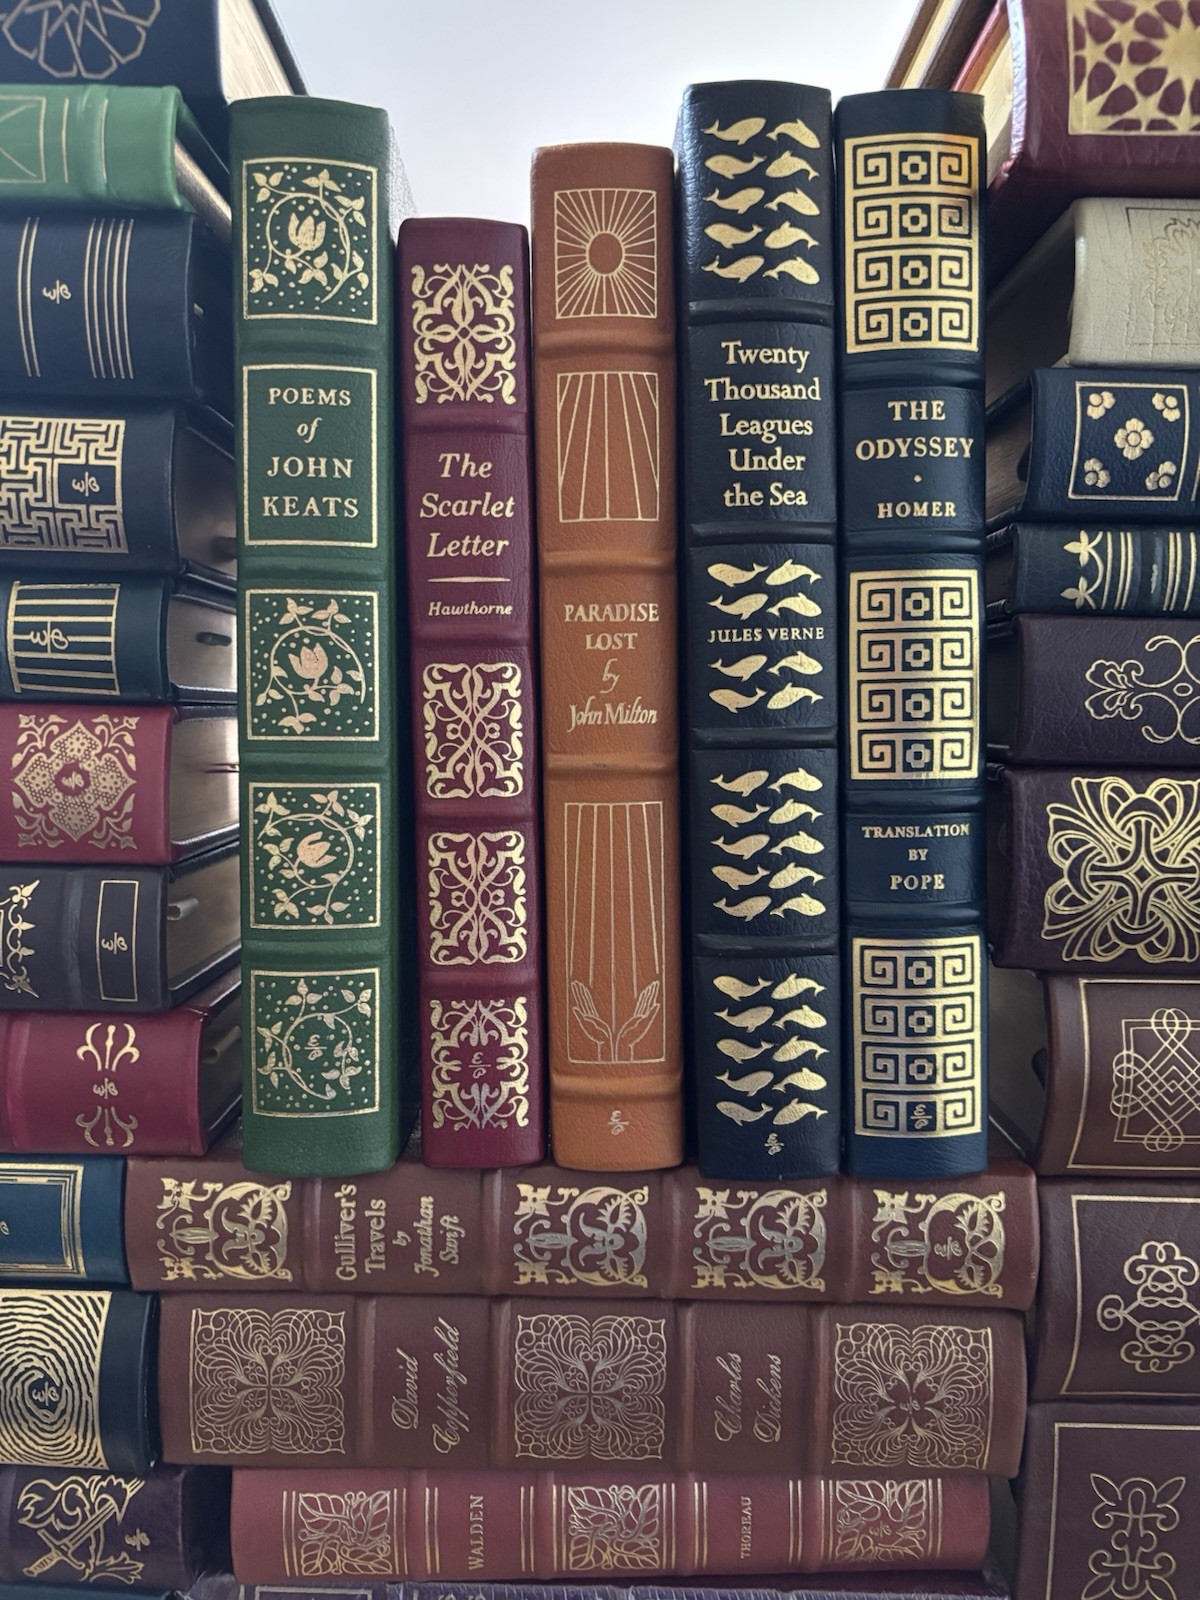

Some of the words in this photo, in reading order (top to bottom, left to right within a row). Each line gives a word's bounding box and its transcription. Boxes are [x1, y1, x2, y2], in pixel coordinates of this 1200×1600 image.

[721, 340, 810, 373] Twenty
[268, 387, 352, 407] POEMS
[704, 377, 822, 402] Thousand
[888, 400, 946, 421] THE
[296, 417, 323, 444] of
[719, 413, 814, 444] Leagues
[728, 446, 806, 472] Under
[855, 437, 974, 461] ODYSSEY
[266, 456, 354, 479] JOHN
[438, 453, 493, 479] The
[262, 496, 359, 518] KEATS
[419, 492, 515, 519] Scarlet
[723, 484, 764, 507] the
[769, 482, 809, 507] Sea
[877, 501, 957, 519] HOMER
[426, 533, 510, 558] Letter
[428, 601, 514, 617] Hawthorne
[564, 603, 660, 623] PARADISE
[585, 633, 638, 651] LOST
[708, 628, 763, 644] JULES
[766, 627, 825, 641] VERNE
[600, 658, 621, 694] by
[566, 695, 603, 733] John
[604, 696, 659, 725] Milton
[861, 823, 970, 839] TRANSLATION
[908, 848, 929, 861] BY
[889, 873, 945, 891] POPE
[333, 1183, 358, 1282] Gulliver's
[364, 1198, 387, 1274] Travels
[392, 1230, 412, 1247] by
[412, 1195, 440, 1278] Jonathan
[438, 1214, 466, 1265] Swift
[391, 1346, 420, 1430] David
[431, 1316, 470, 1454] Copperfield
[714, 1351, 743, 1442] Charles
[752, 1353, 782, 1443] Dickens
[468, 1494, 485, 1571] WALDEN
[740, 1495, 753, 1560] THOREAU
